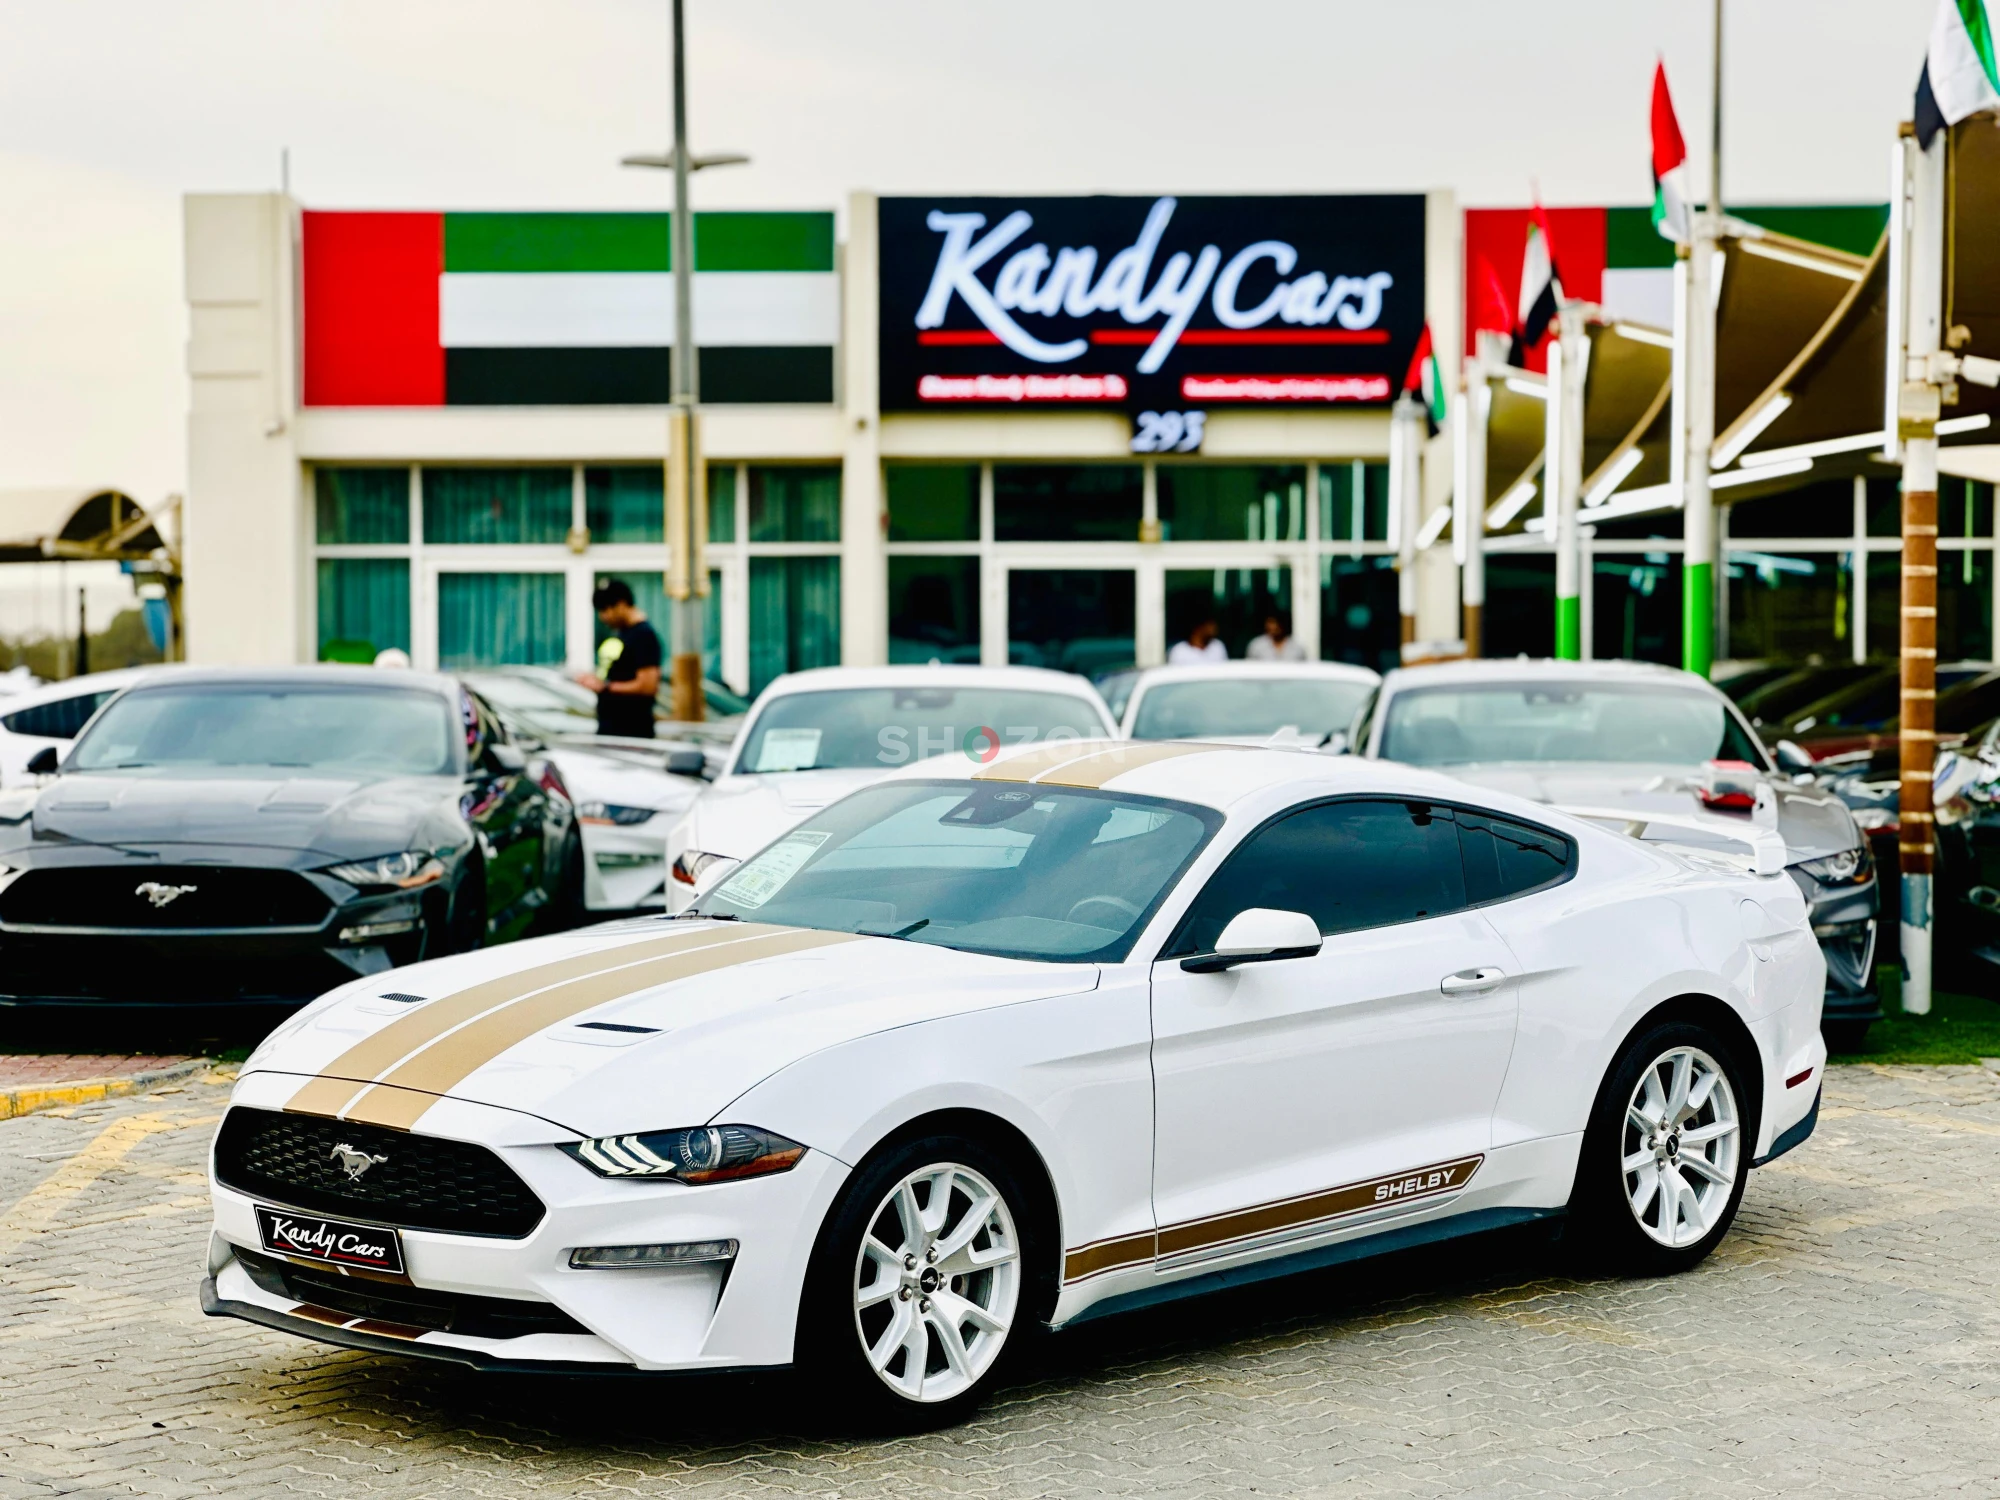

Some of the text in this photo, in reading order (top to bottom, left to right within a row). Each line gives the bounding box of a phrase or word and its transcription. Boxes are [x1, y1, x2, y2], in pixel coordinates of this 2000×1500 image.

[915, 197, 1392, 373] Kandy Cars
[1375, 1169, 1456, 1200] SHELBY
[271, 1216, 386, 1258] Kandy Cars
